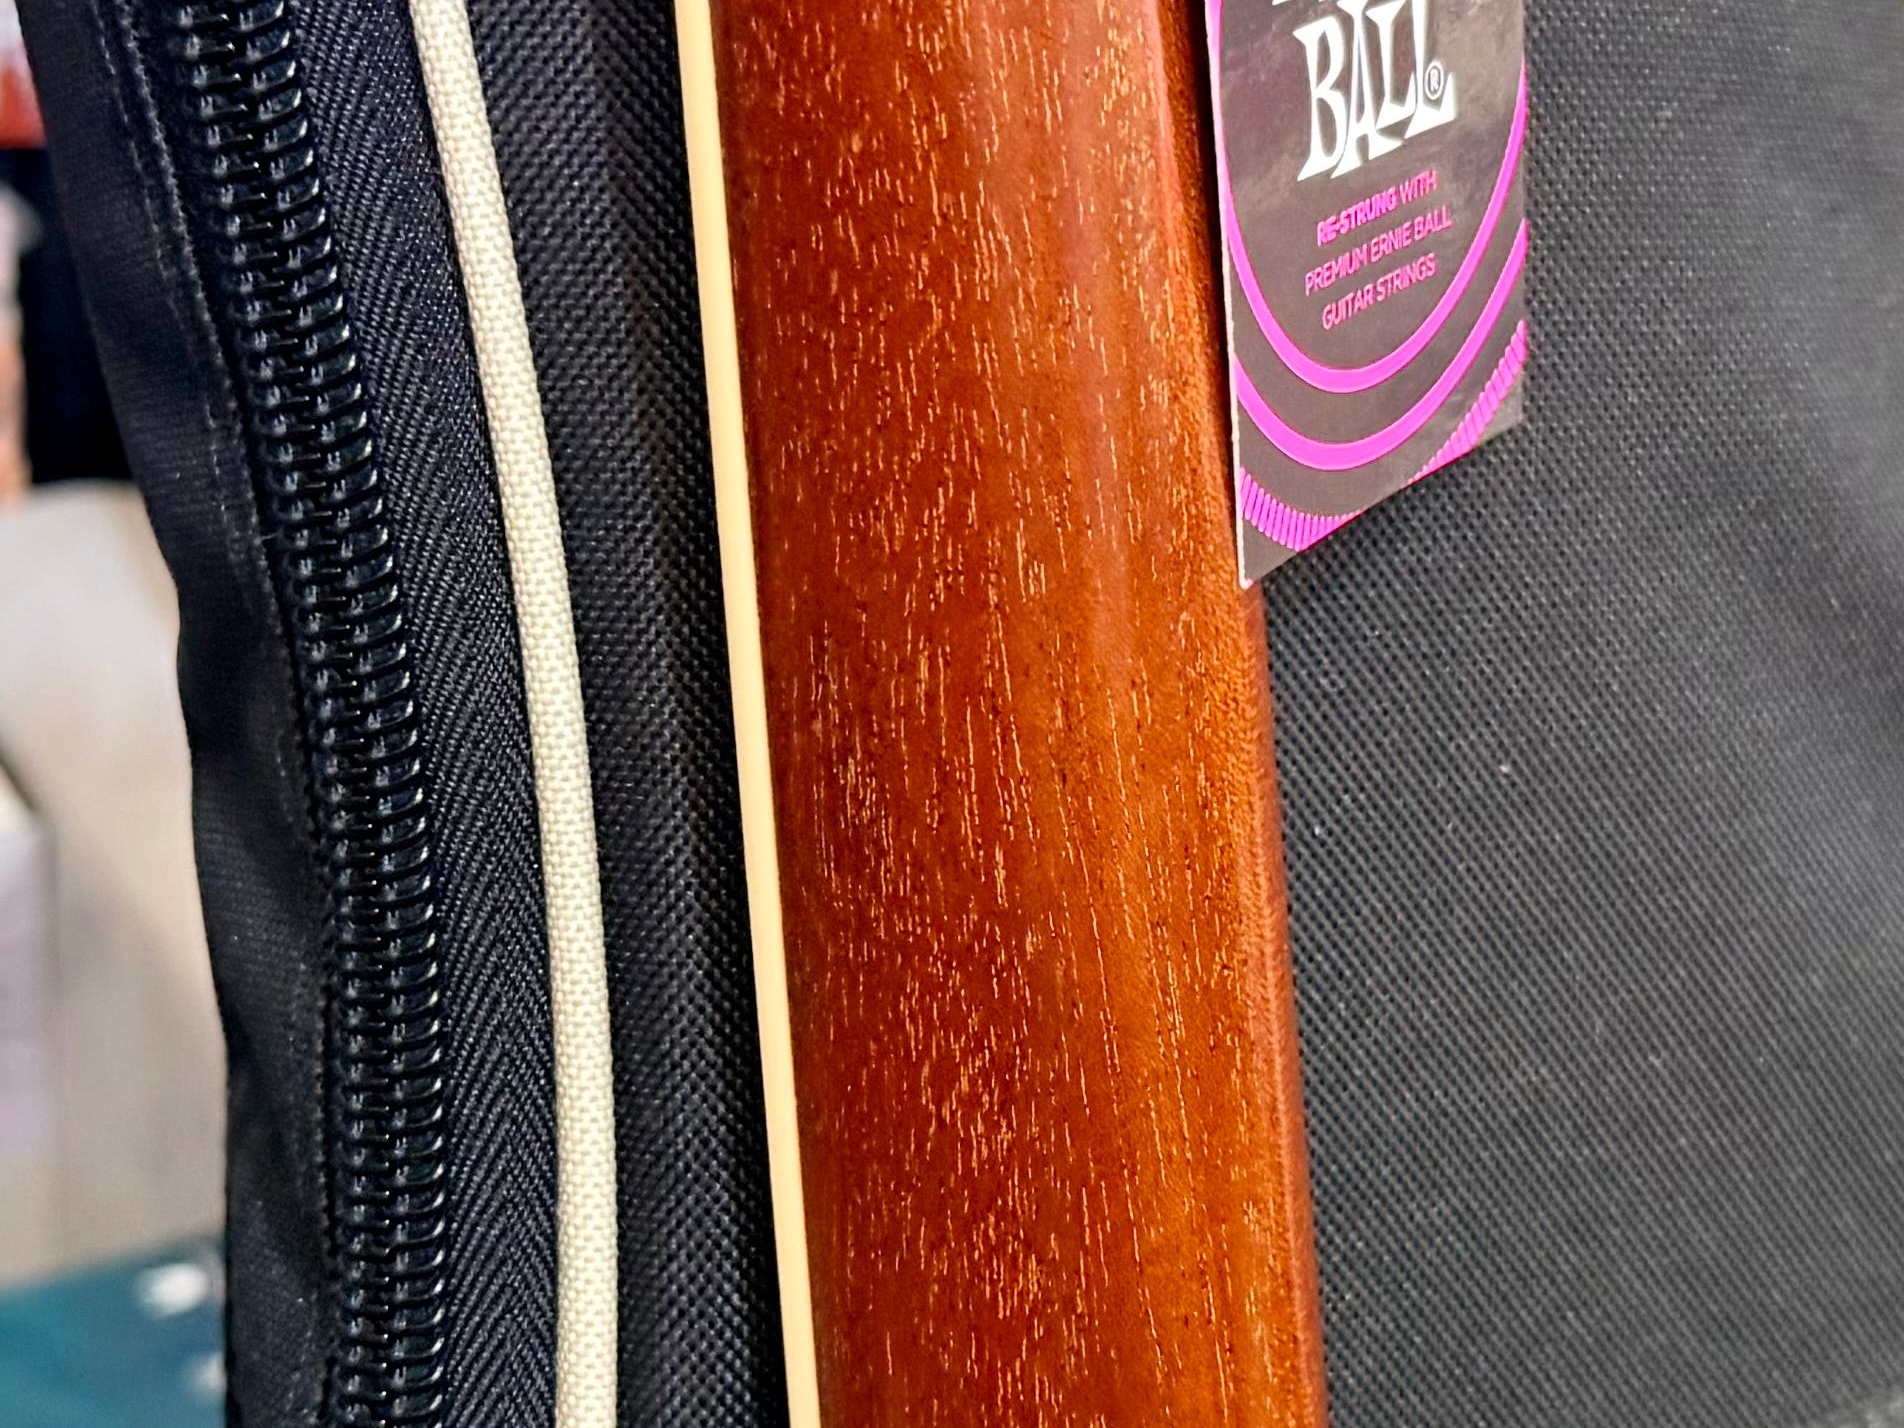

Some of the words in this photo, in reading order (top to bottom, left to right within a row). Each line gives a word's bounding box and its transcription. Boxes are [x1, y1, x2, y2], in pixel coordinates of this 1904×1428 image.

[1316, 185, 1398, 247] RE-STRUNG
[1398, 168, 1438, 205] WITH
[1304, 243, 1368, 296] PREMIUM
[1370, 221, 1413, 263] ERNIE
[1414, 205, 1454, 241] BALL
[1322, 283, 1374, 331] GUITAR
[1376, 252, 1437, 302] STRINGS
